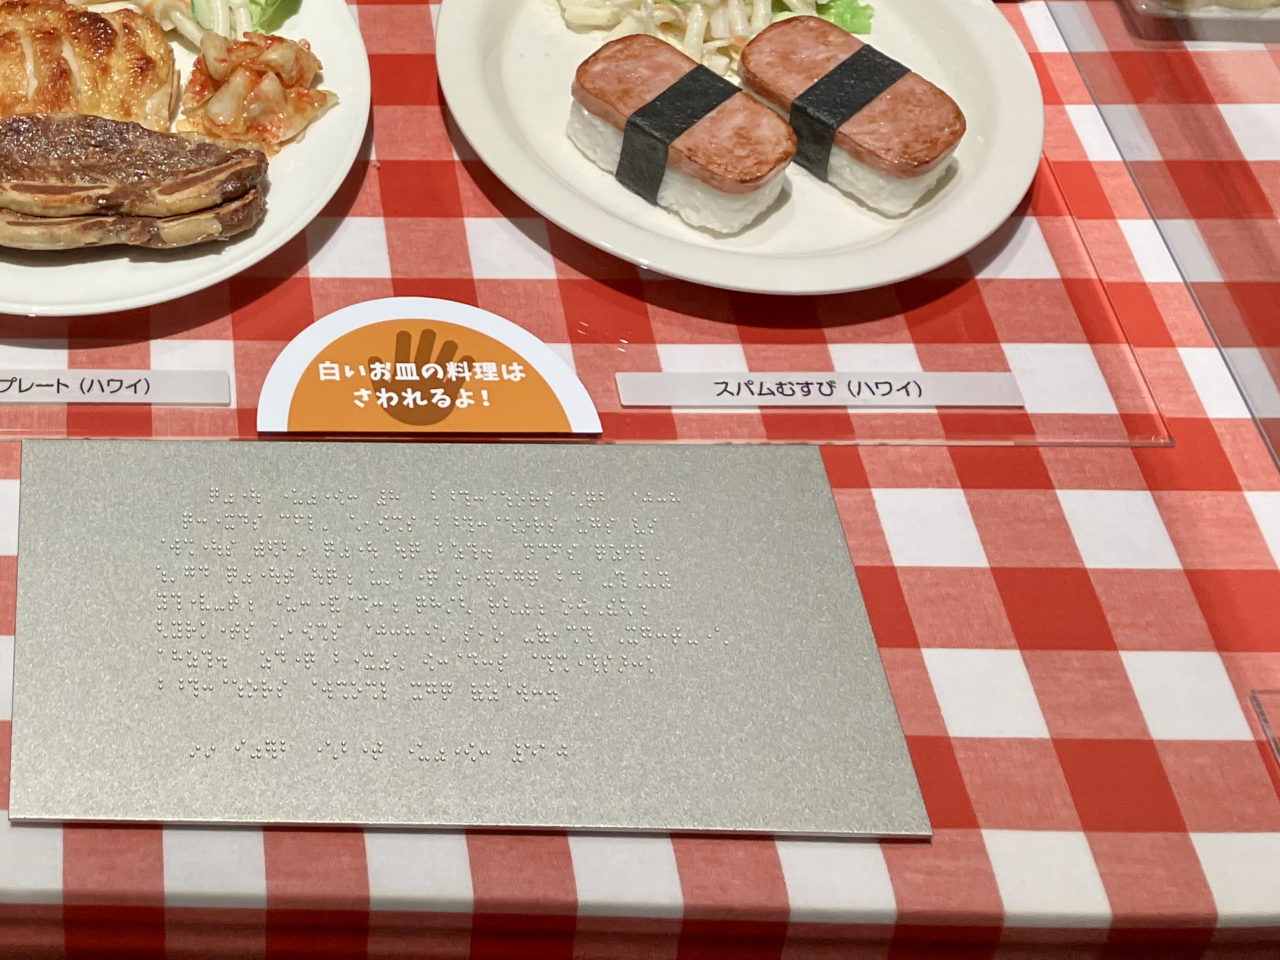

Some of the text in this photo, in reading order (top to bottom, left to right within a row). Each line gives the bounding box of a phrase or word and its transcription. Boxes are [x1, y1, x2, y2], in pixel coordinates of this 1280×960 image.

[318, 361, 526, 382] 白いお皿の料理は
